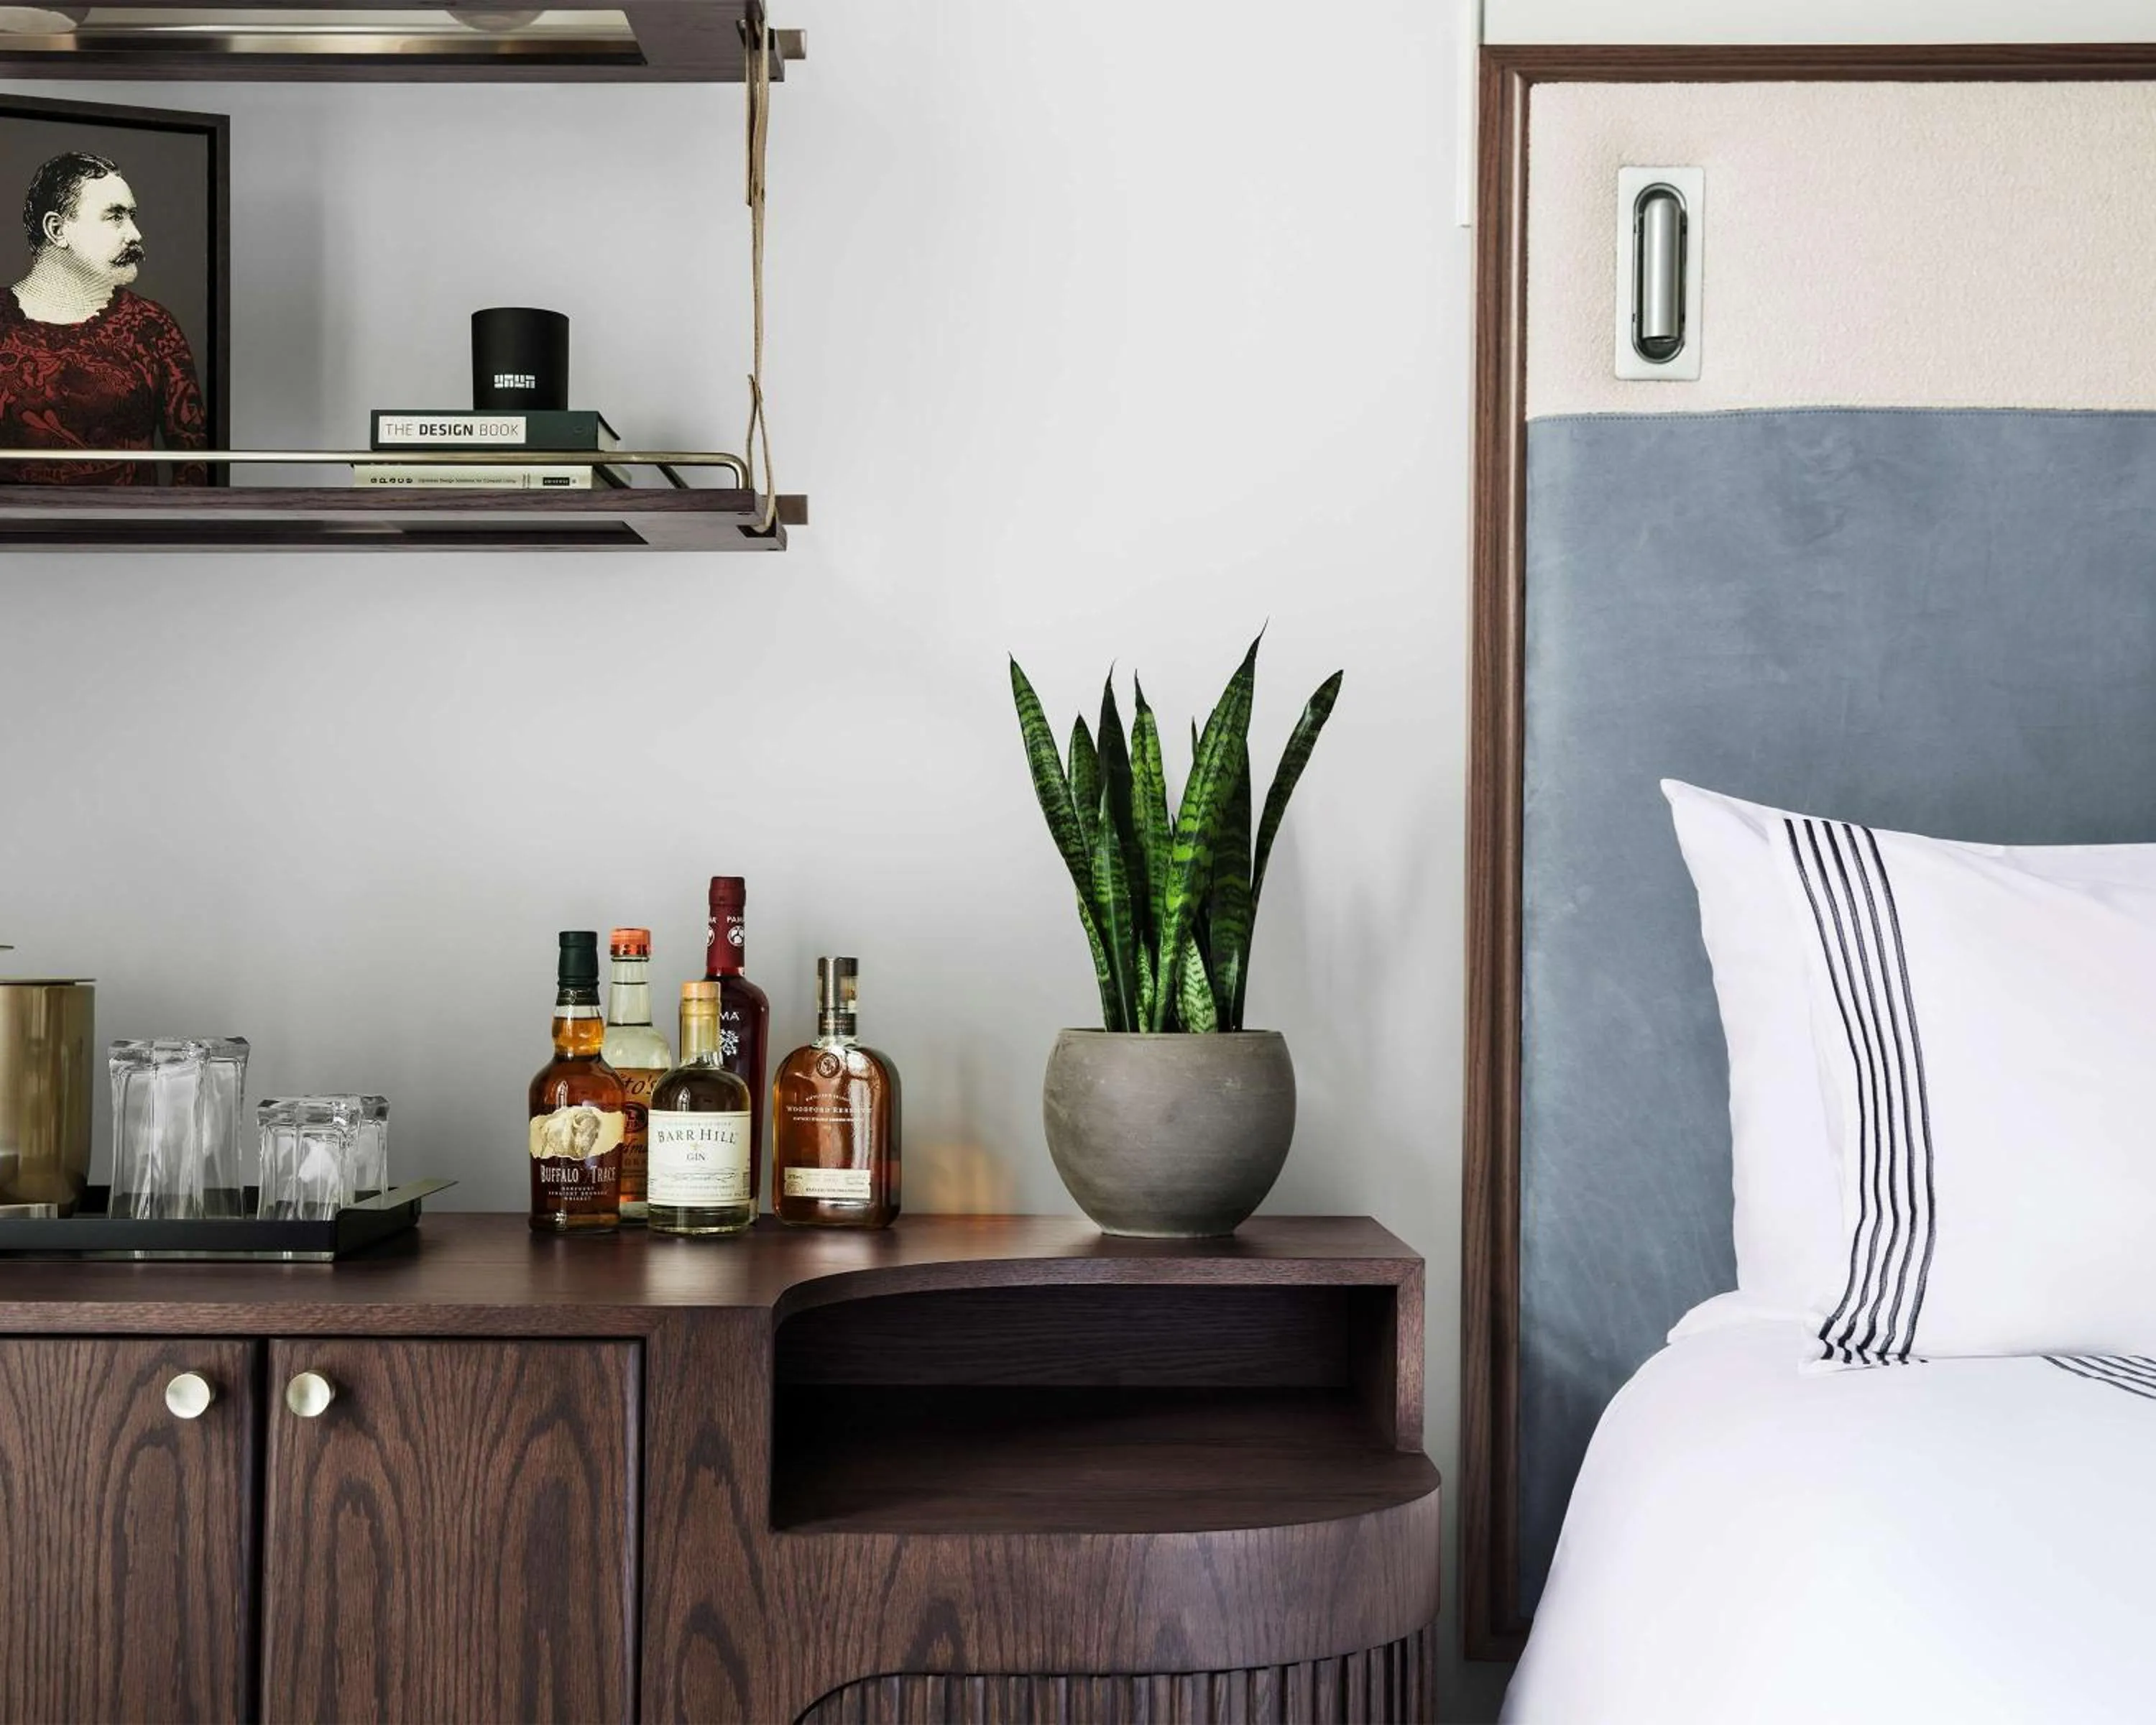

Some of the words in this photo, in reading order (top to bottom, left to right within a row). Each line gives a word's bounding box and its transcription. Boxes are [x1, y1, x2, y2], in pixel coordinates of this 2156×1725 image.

[385, 423, 413, 436] THE
[419, 423, 474, 436] DESIGN
[479, 423, 519, 436] BOOK
[719, 1011, 740, 1021] MA
[658, 1128, 695, 1144] BARR
[700, 1128, 736, 1144] HILL
[686, 1152, 706, 1162] GIN
[540, 1164, 579, 1183] BUFFALO
[590, 1165, 617, 1184] TRACE
